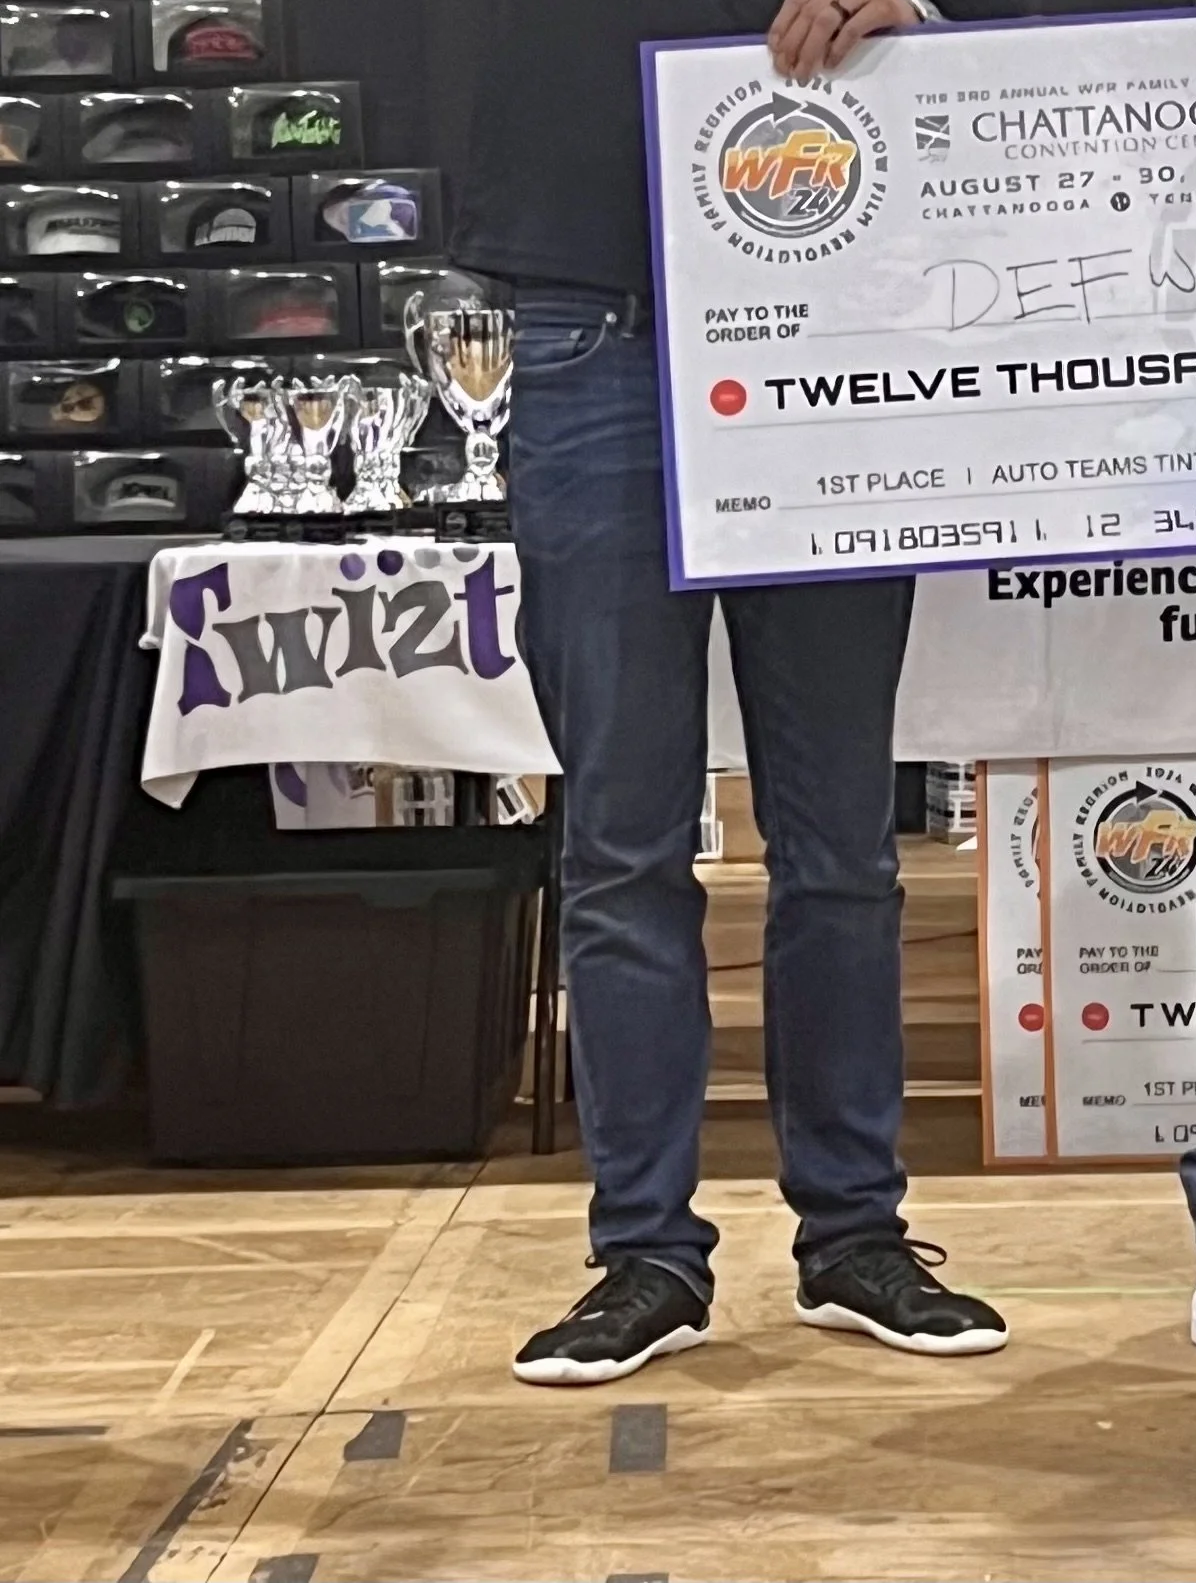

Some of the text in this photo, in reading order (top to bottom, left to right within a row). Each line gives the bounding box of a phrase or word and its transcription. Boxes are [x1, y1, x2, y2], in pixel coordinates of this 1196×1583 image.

[1000, 85, 1069, 100] ANNUAL
[1126, 76, 1191, 92] FAMILY
[1004, 135, 1158, 160] CONVENTION
[722, 129, 857, 200] WFR
[920, 173, 1041, 198] AUGUST
[1057, 170, 1096, 189] 27
[921, 197, 1092, 221] CHATTANOOGA
[705, 303, 809, 325] PAY TO THE
[705, 322, 801, 344] ORDER OF
[764, 365, 982, 411] TWELVE
[714, 496, 772, 514] MEMO
[816, 473, 860, 497] 1ST
[866, 467, 946, 493] PLACE
[991, 460, 1058, 486] AUTO
[1065, 455, 1148, 480] TEAMS
[1078, 945, 1159, 959] PAY TO THE
